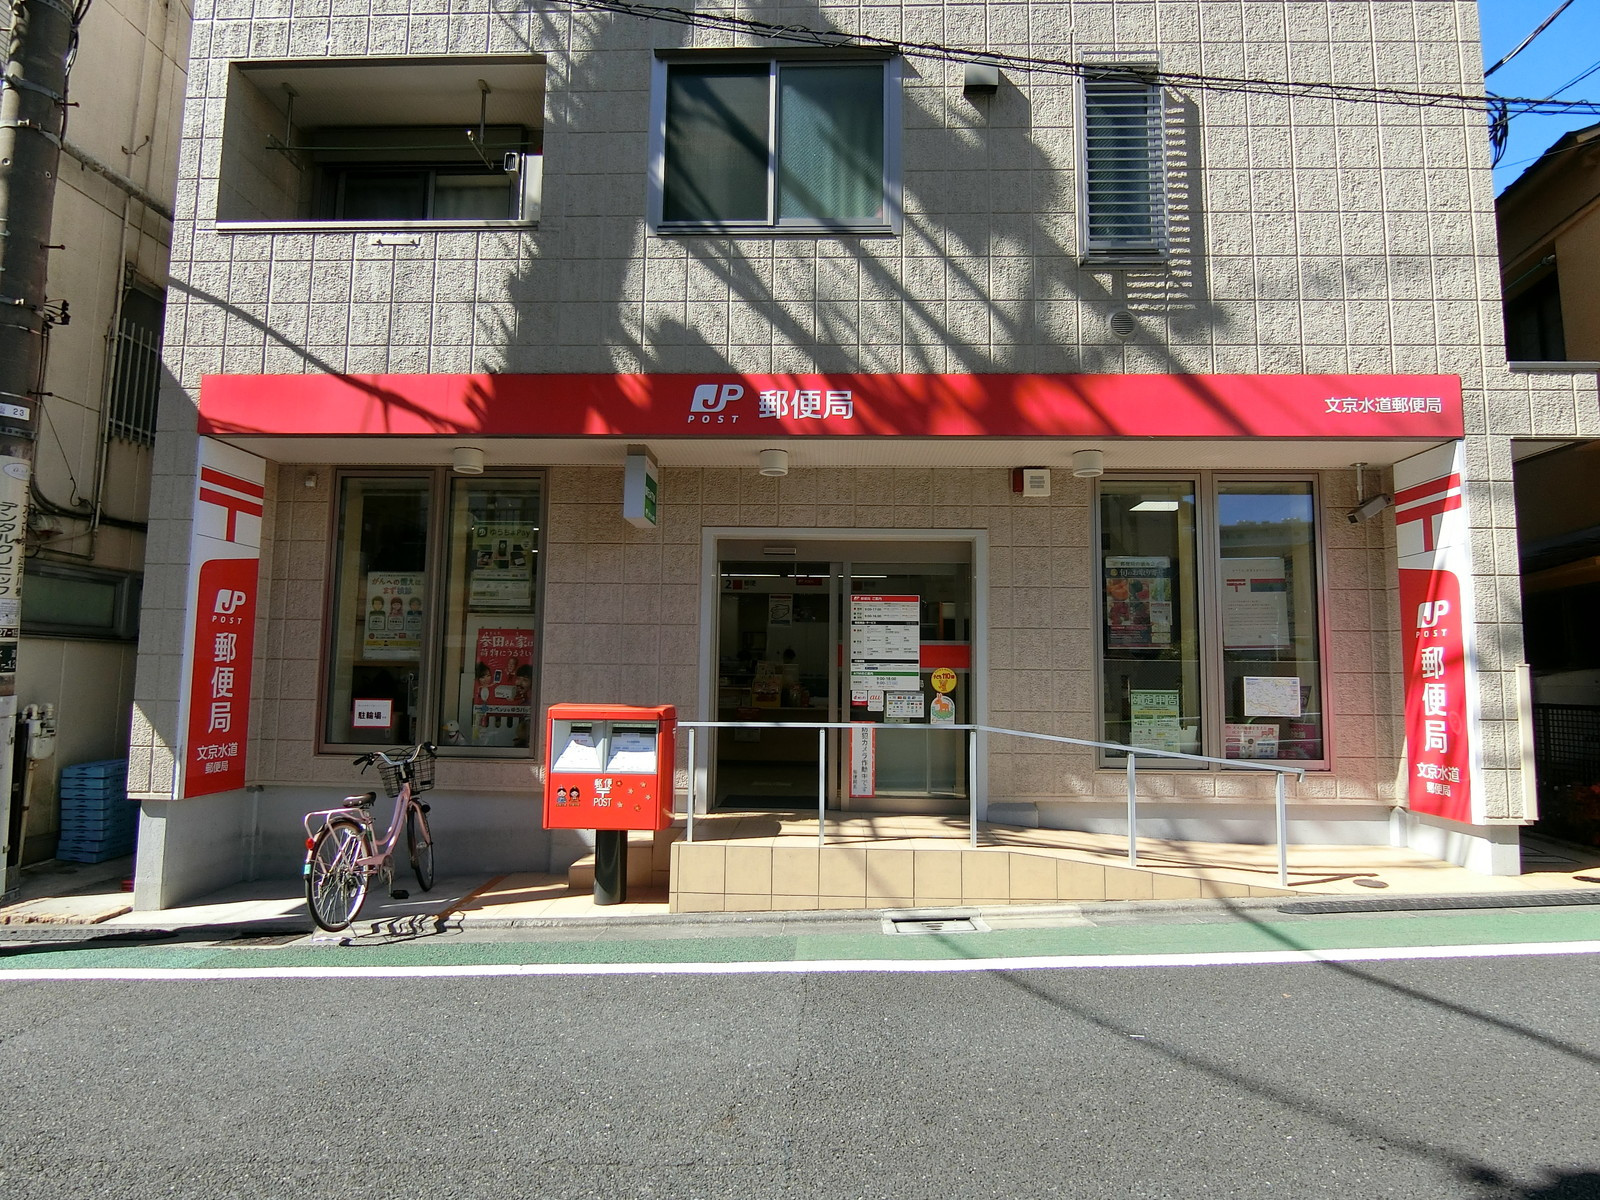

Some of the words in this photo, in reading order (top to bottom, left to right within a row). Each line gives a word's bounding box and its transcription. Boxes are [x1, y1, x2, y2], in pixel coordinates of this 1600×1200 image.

[759, 389, 854, 419] 郵便局
[1324, 397, 1442, 413] 文京水道郵便局
[687, 415, 739, 423] POST
[212, 615, 243, 625] POST
[1415, 628, 1448, 638] POST
[207, 632, 238, 735] 郵便局
[1421, 646, 1449, 754] 郵便局
[358, 711, 382, 719] 駐輪場
[196, 742, 239, 761] 文京水道
[204, 761, 229, 774] 郵便局
[1416, 762, 1461, 783] 文京水道
[594, 778, 613, 789] 郵便
[1426, 781, 1452, 798] 郵便局
[593, 797, 613, 807] POST
